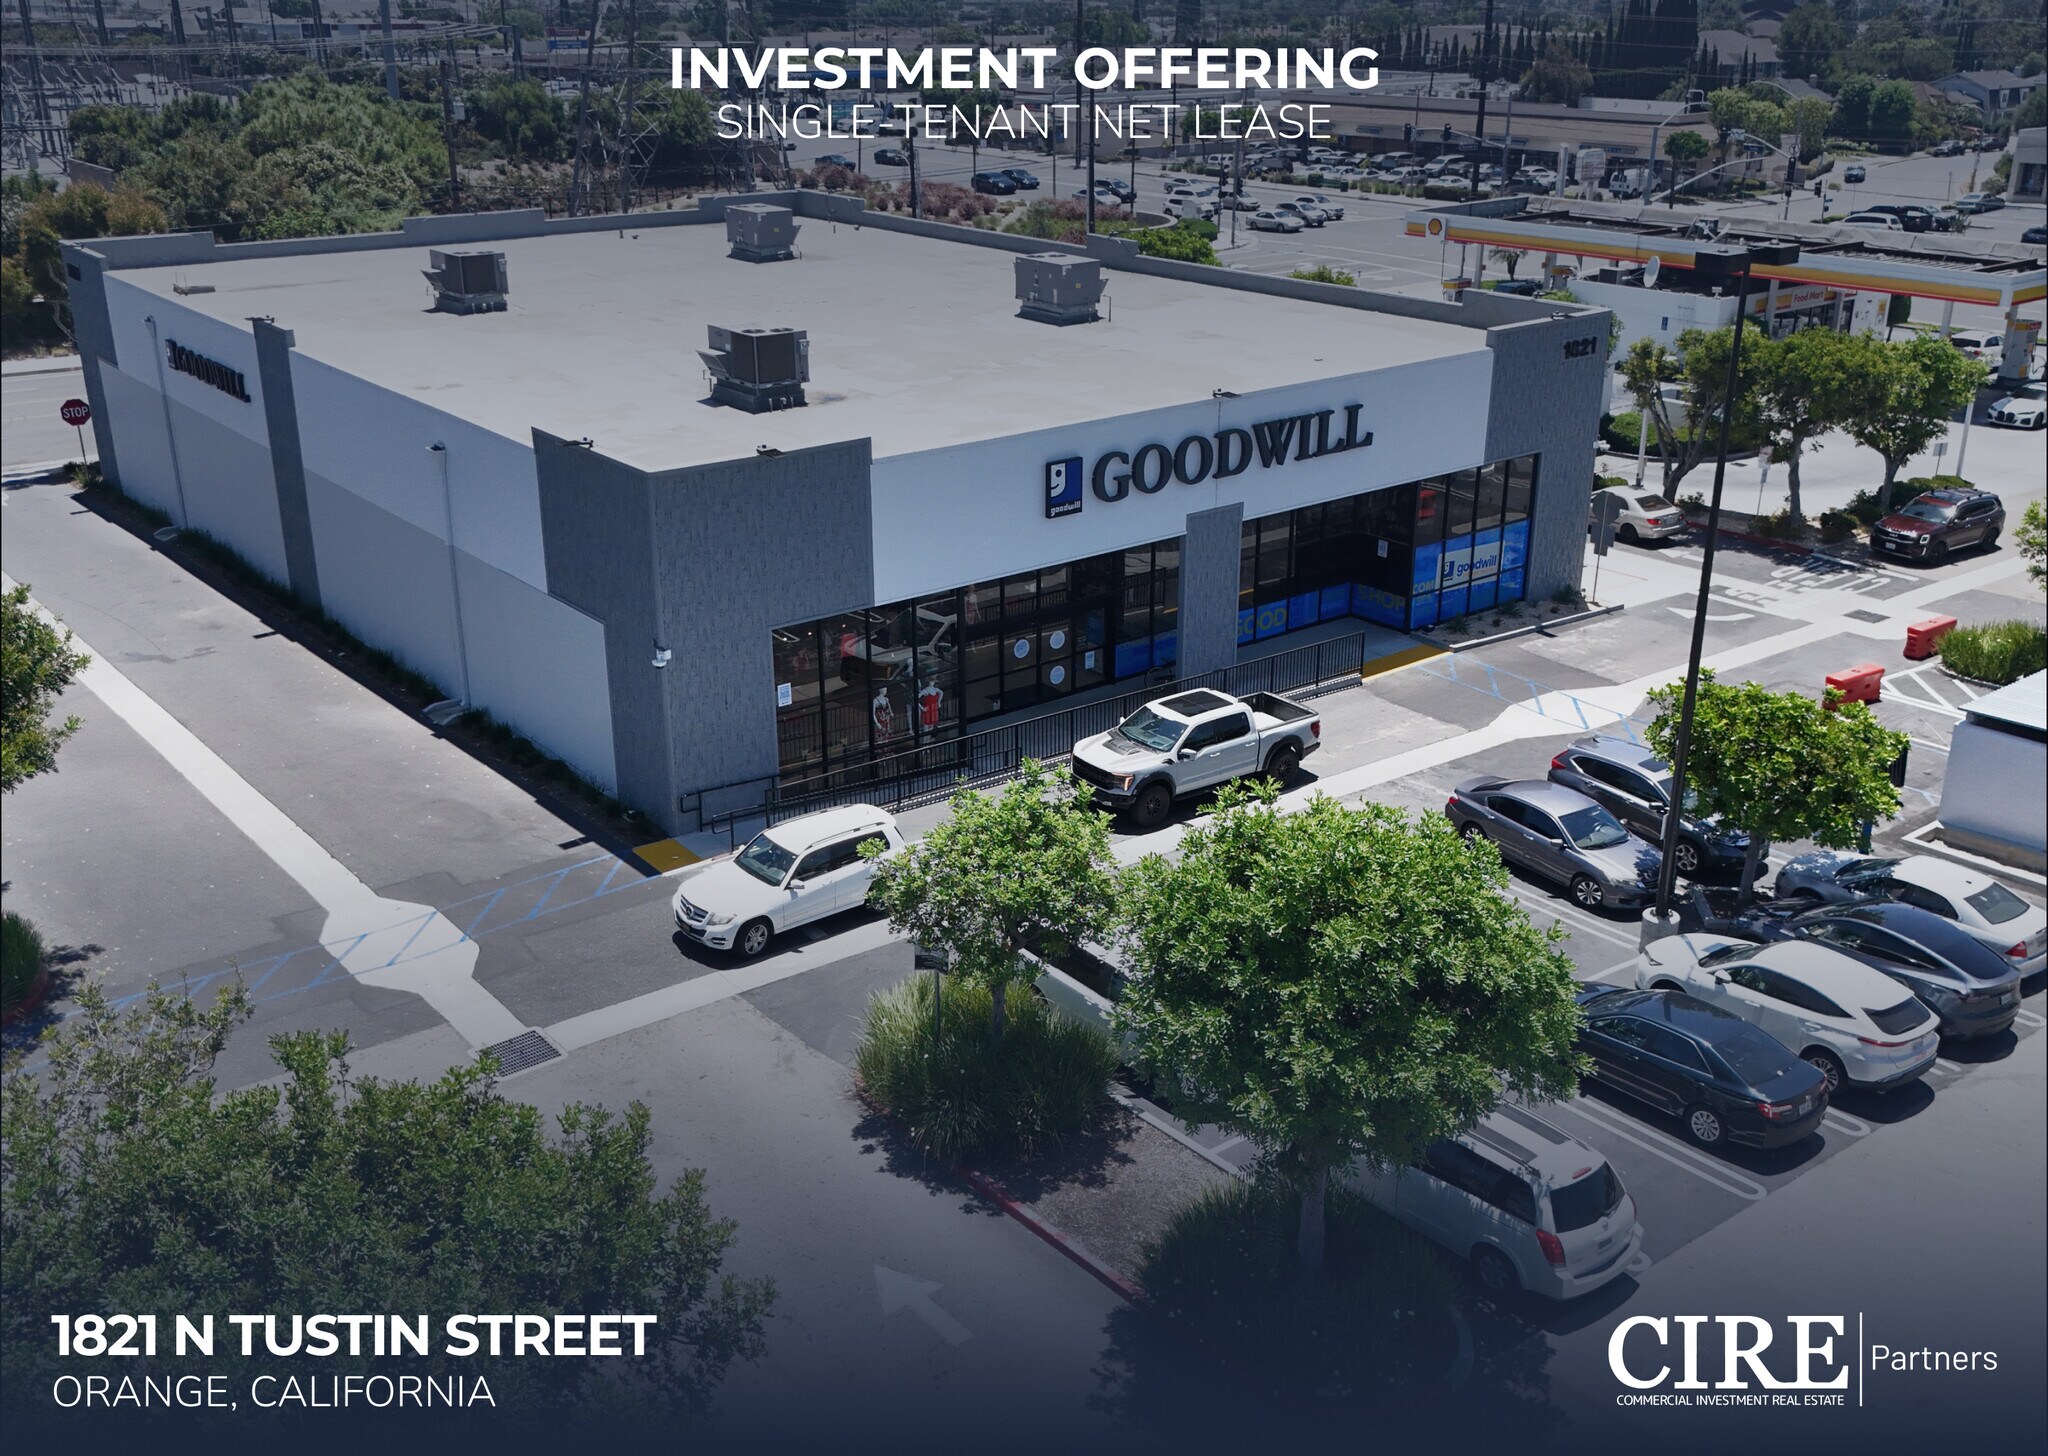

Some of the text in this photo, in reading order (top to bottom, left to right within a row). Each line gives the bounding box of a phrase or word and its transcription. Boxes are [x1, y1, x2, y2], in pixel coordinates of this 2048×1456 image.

[1563, 336, 1598, 360] 1821
[63, 406, 88, 418] STOP
[1091, 403, 1374, 503] GOODWILL
[1050, 500, 1081, 517] goodwill
